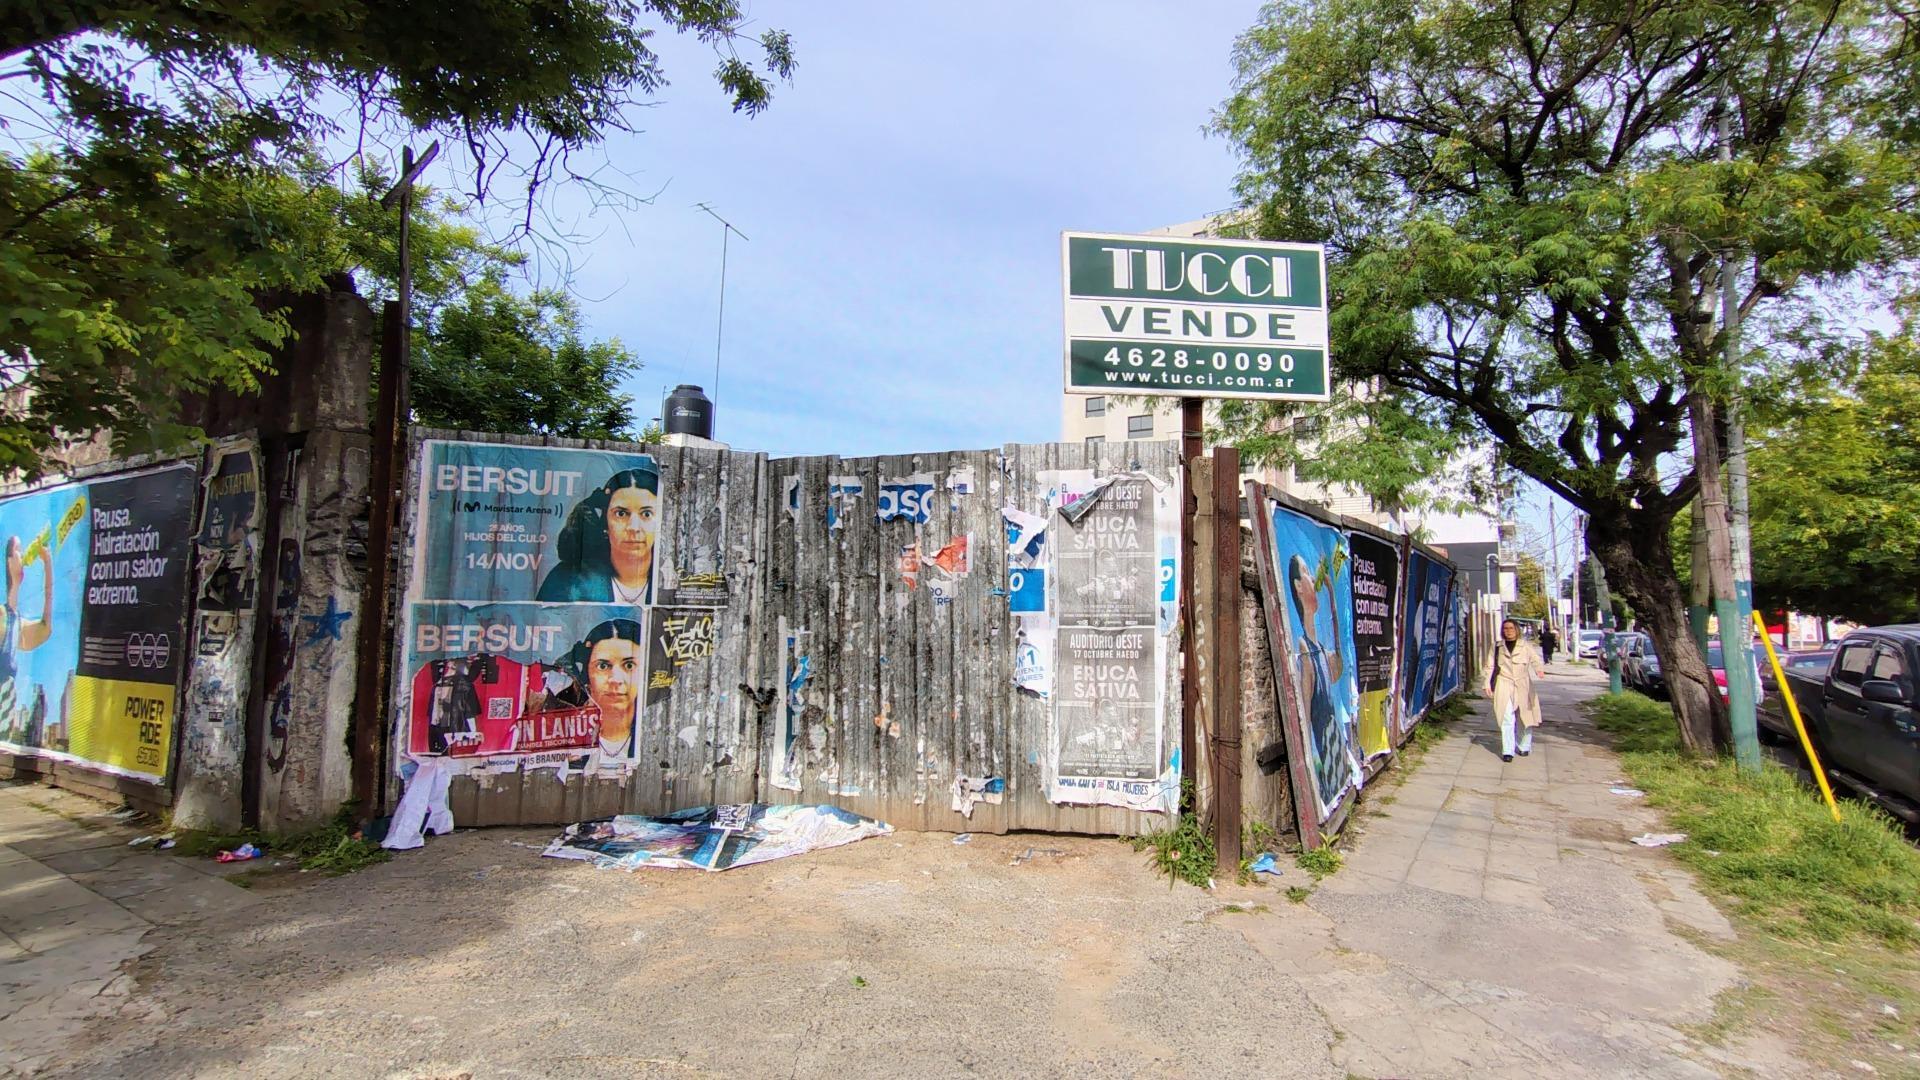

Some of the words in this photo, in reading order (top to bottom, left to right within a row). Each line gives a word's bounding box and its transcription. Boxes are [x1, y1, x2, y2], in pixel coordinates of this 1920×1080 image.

[1101, 247, 1292, 298] TUCCI
[1101, 305, 1296, 340] VENDE
[1104, 347, 1295, 372] 4628-0090
[1105, 370, 1294, 388] www.tucci.com.ar
[436, 464, 582, 496] BERSUIT
[1116, 485, 1142, 500] OESTE
[484, 504, 523, 514] Movistar
[526, 505, 552, 515] Arena
[1116, 501, 1138, 510] HAEDO
[93, 507, 131, 530] Pausa.
[499, 522, 525, 533] AÑOS
[94, 524, 160, 556] Hidratación
[464, 532, 495, 541] HIJOS
[496, 533, 517, 542] DEL
[518, 533, 547, 543] CULO
[1074, 533, 1139, 550] SATIVA
[91, 561, 113, 580] con
[115, 560, 129, 579] un
[131, 554, 168, 578] sabor
[466, 552, 543, 571] 14/NOV
[1354, 553, 1376, 576] Pausa.
[88, 583, 139, 605] extremo.
[1356, 599, 1370, 615] con
[1356, 617, 1383, 635] extremo.
[416, 624, 562, 652] BERSUIT
[1070, 634, 1113, 649] AUDITORIO
[1116, 634, 1142, 649] OESTE
[1026, 650, 1035, 666] 1
[1074, 650, 1082, 659] 17
[1084, 650, 1113, 659] OCTUBRE
[1116, 650, 1139, 659] HAEDO
[1073, 665, 1139, 682] ERUCA
[1074, 682, 1139, 699] SATIVA
[125, 696, 164, 721] POWER
[139, 721, 162, 745] ADE
[541, 710, 599, 740] LANÚS
[1107, 780, 1120, 793] ISLA
[1122, 782, 1148, 796] MUJERES
